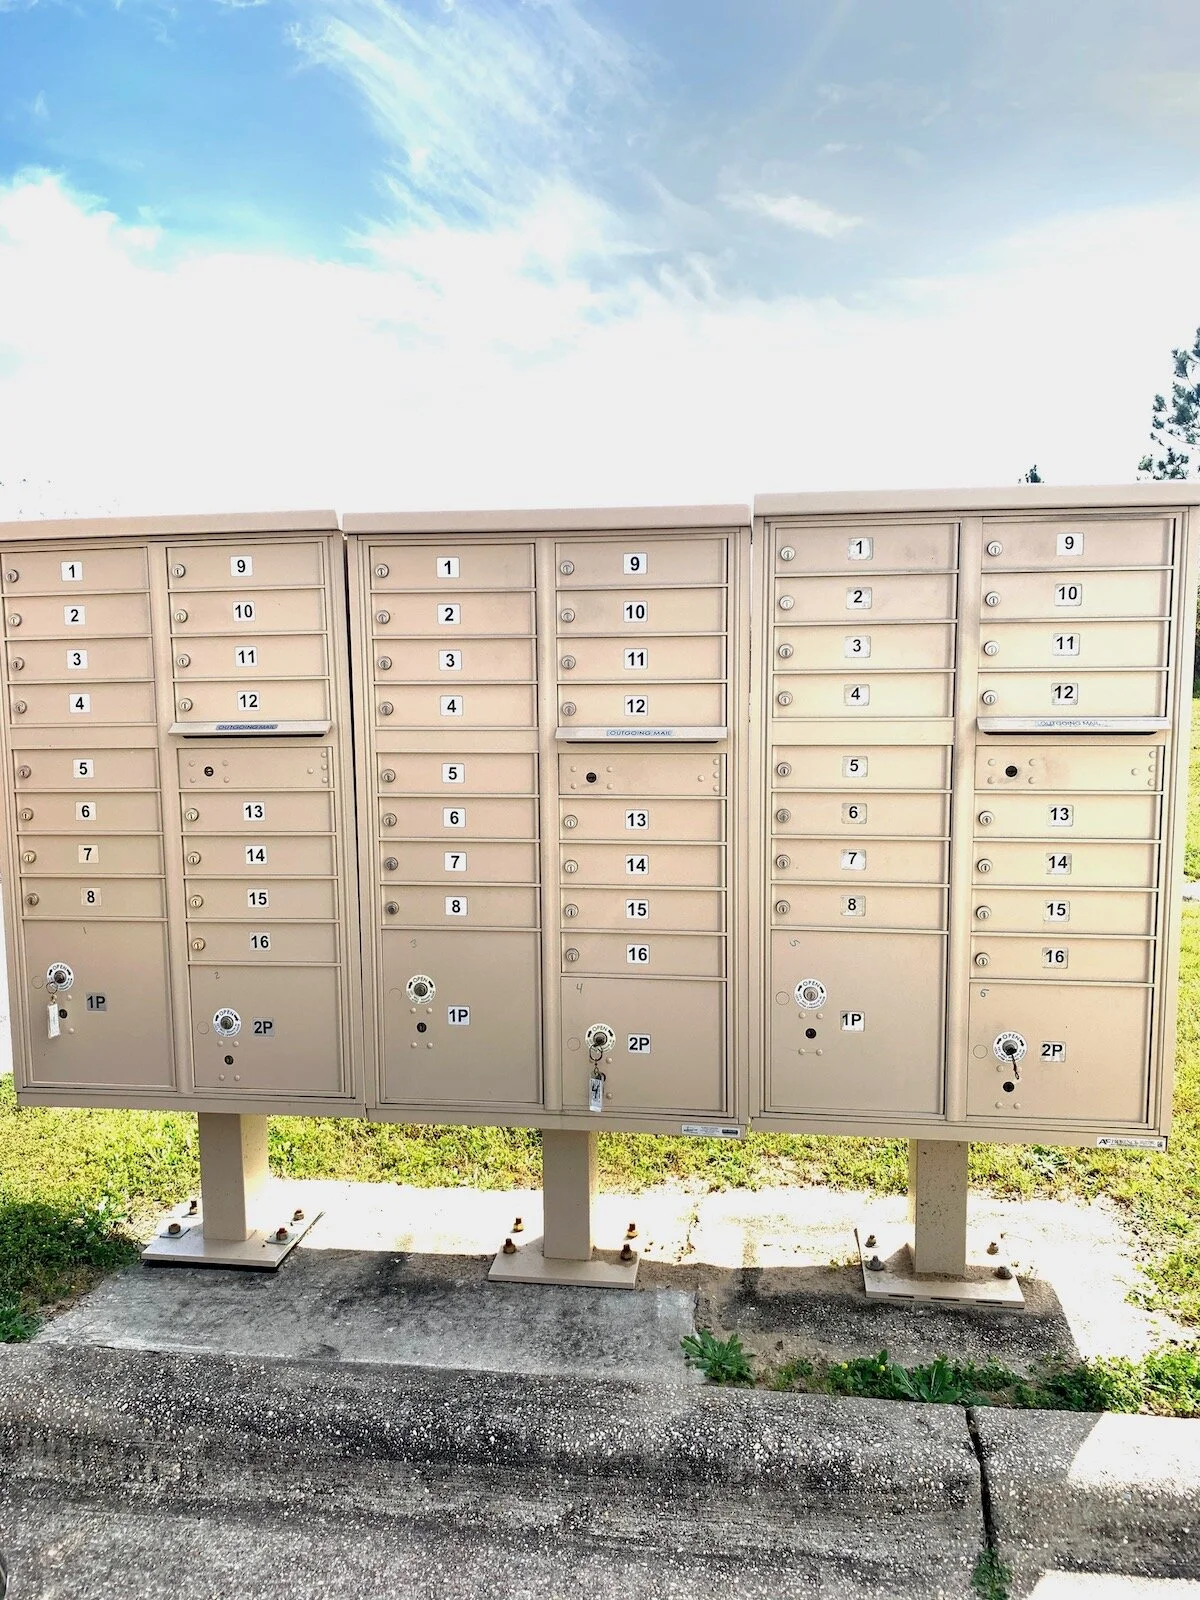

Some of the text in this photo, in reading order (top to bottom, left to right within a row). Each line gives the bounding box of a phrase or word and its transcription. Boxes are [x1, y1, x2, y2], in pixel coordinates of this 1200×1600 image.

[856, 541, 862, 554] 1
[1065, 537, 1074, 550] 9
[237, 560, 246, 573] 9
[444, 561, 451, 575] 1
[630, 557, 640, 571] 9
[68, 565, 75, 578] 1
[853, 591, 863, 603] 2
[1058, 587, 1078, 600] 10
[70, 610, 79, 622] 2
[235, 605, 253, 619] 10
[444, 608, 454, 622] 2
[626, 605, 645, 619] 10
[852, 640, 862, 653] 3
[1056, 637, 1074, 650] 11
[73, 653, 81, 666] 3
[238, 650, 255, 664] 11
[446, 654, 455, 668] 3
[628, 653, 644, 666] 11
[851, 688, 861, 700] 4
[1054, 686, 1074, 699] 12
[75, 697, 85, 710] 4
[239, 695, 258, 708] 12
[447, 700, 457, 713] 4
[627, 700, 645, 713] 12
[79, 763, 88, 775] 5
[850, 760, 859, 772] 5
[448, 767, 458, 780] 5
[81, 806, 90, 818] 6
[245, 806, 263, 818] 13
[450, 812, 459, 825] 6
[849, 806, 858, 819] 6
[1050, 808, 1069, 821] 13
[627, 813, 646, 827] 13
[83, 848, 92, 861] 7
[247, 849, 265, 862] 14
[848, 853, 858, 865] 7
[450, 856, 460, 869] 7
[627, 859, 646, 872] 14
[1048, 856, 1068, 869] 14
[87, 891, 95, 904] 8
[249, 893, 267, 906] 15
[452, 900, 461, 913] 8
[628, 903, 647, 917] 15
[847, 899, 857, 911] 8
[1047, 904, 1066, 917] 15
[251, 936, 269, 949] 16
[628, 948, 648, 961] 16
[1045, 950, 1065, 963] 16
[413, 976, 428, 984] OPEN
[803, 980, 820, 988] OPEN
[576, 983, 583, 993] 4
[87, 996, 106, 1009] 1P
[218, 1009, 234, 1017] OPEN
[449, 1010, 468, 1023] 1P
[842, 1014, 862, 1026] 1P
[254, 1021, 273, 1034] 2P
[1002, 1033, 1020, 1041] OPEN
[629, 1038, 650, 1051] 2P
[1041, 1044, 1063, 1057] 2P
[591, 1083, 600, 1099] 4
